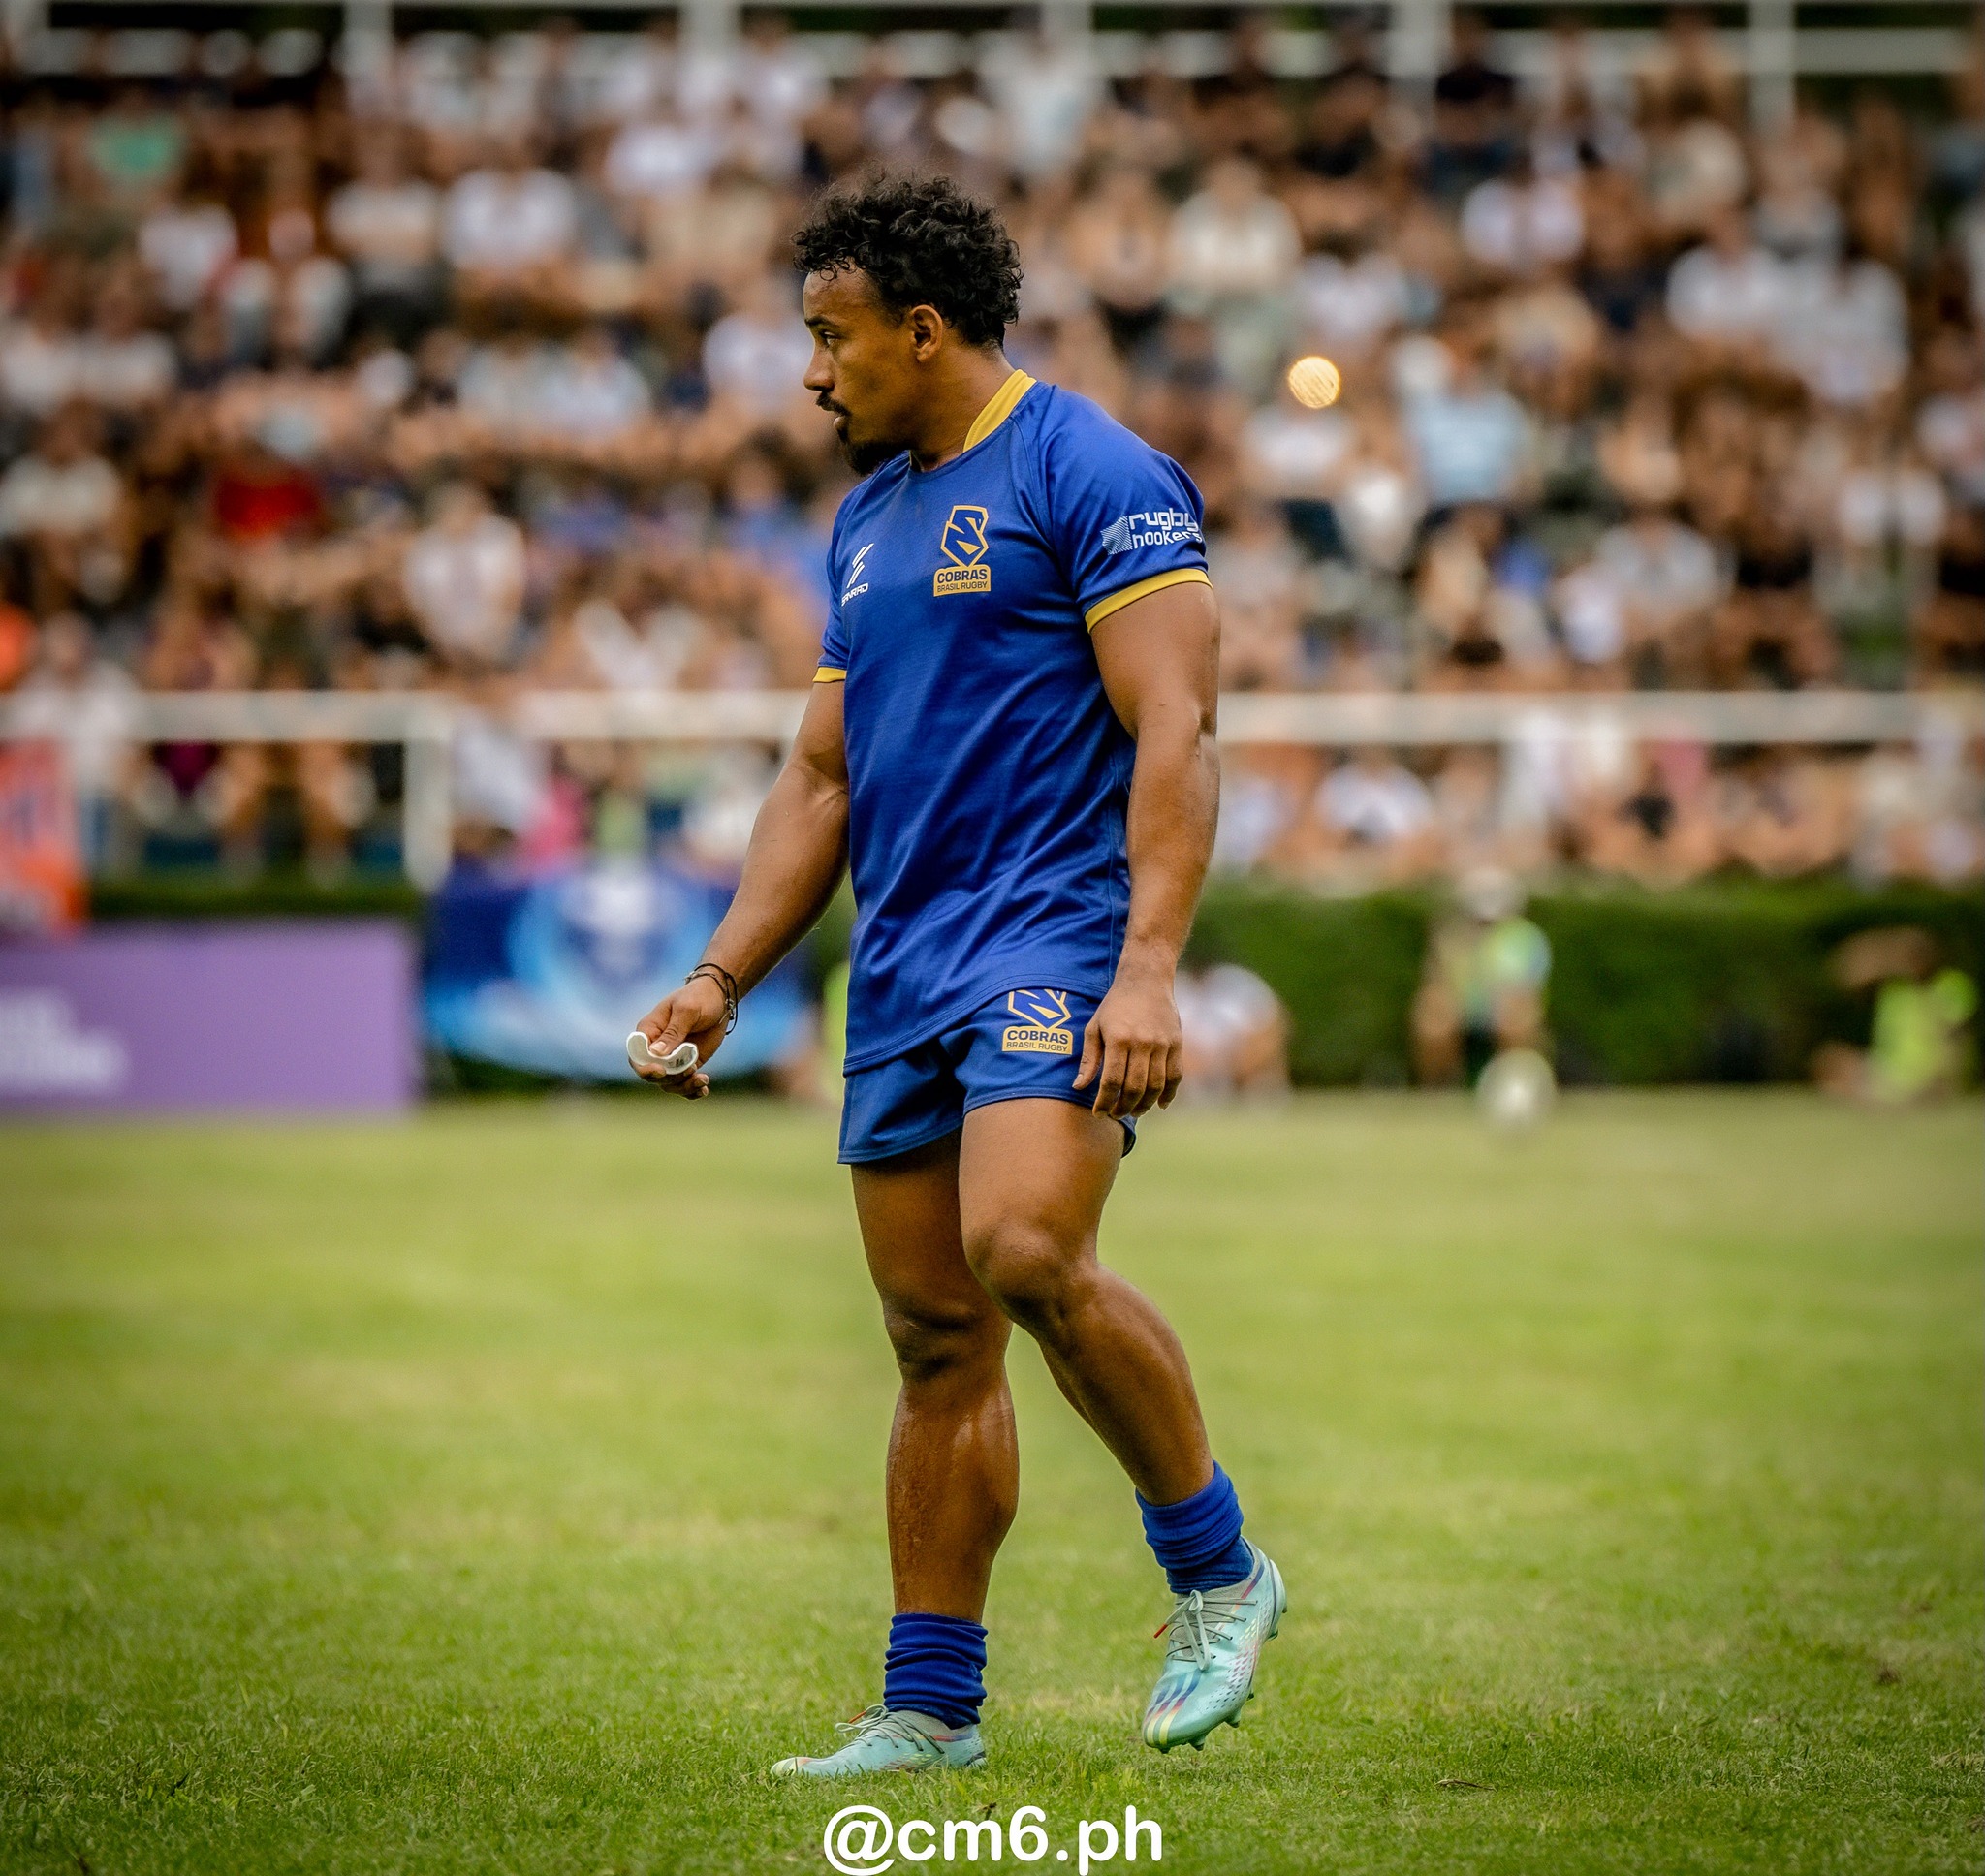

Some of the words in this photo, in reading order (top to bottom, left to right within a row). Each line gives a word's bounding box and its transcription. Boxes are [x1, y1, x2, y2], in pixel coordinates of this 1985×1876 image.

[1128, 508, 1199, 532] rugby
[937, 569, 988, 583] COBRAS
[937, 583, 960, 593] BRASIL
[961, 581, 988, 590] RUGBY
[1007, 1030, 1069, 1045] COBRAS
[1006, 1041, 1037, 1049] BRASIL
[1038, 1043, 1068, 1051] RUGBY
